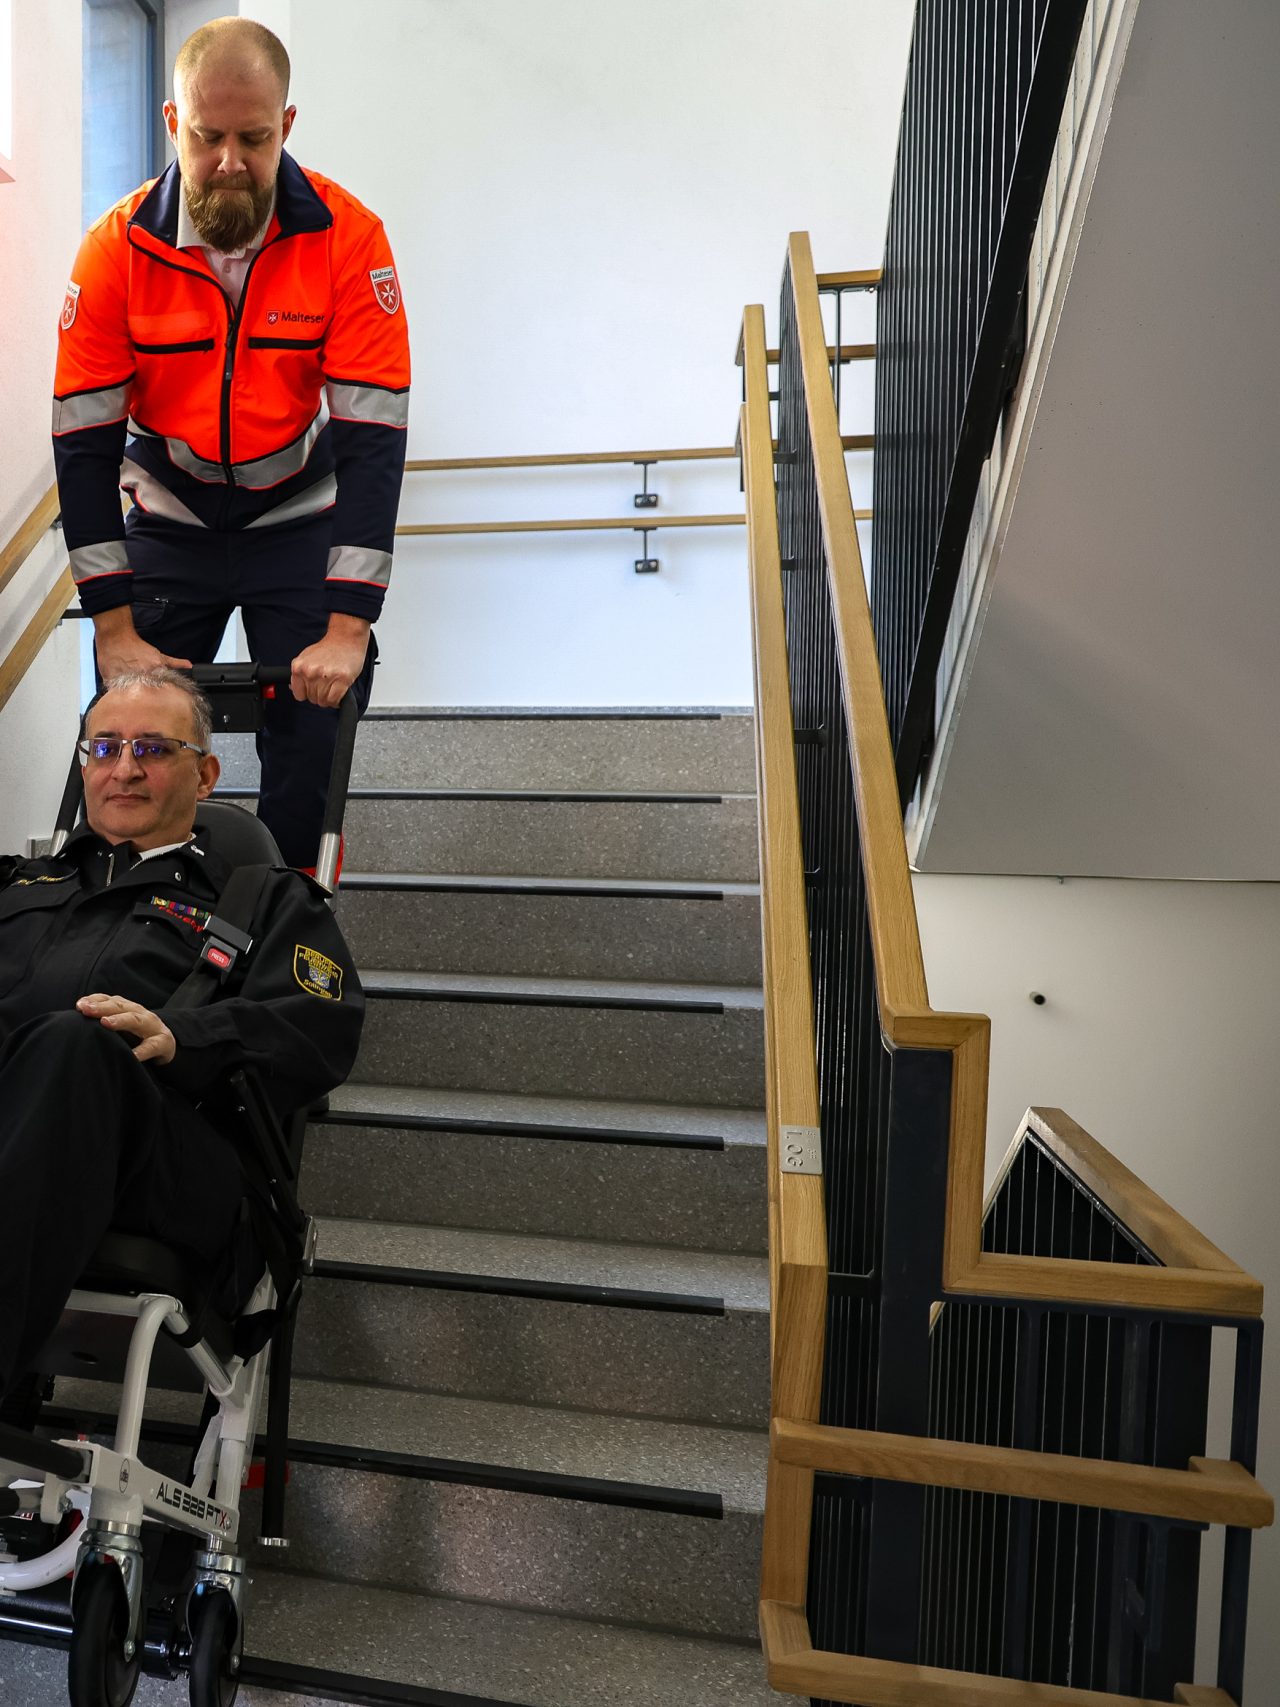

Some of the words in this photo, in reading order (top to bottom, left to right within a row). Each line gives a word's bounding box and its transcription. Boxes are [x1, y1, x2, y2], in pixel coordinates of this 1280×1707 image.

[281, 311, 326, 324] Malteser
[211, 952, 225, 965] PRESS
[156, 1481, 182, 1509] ALS
